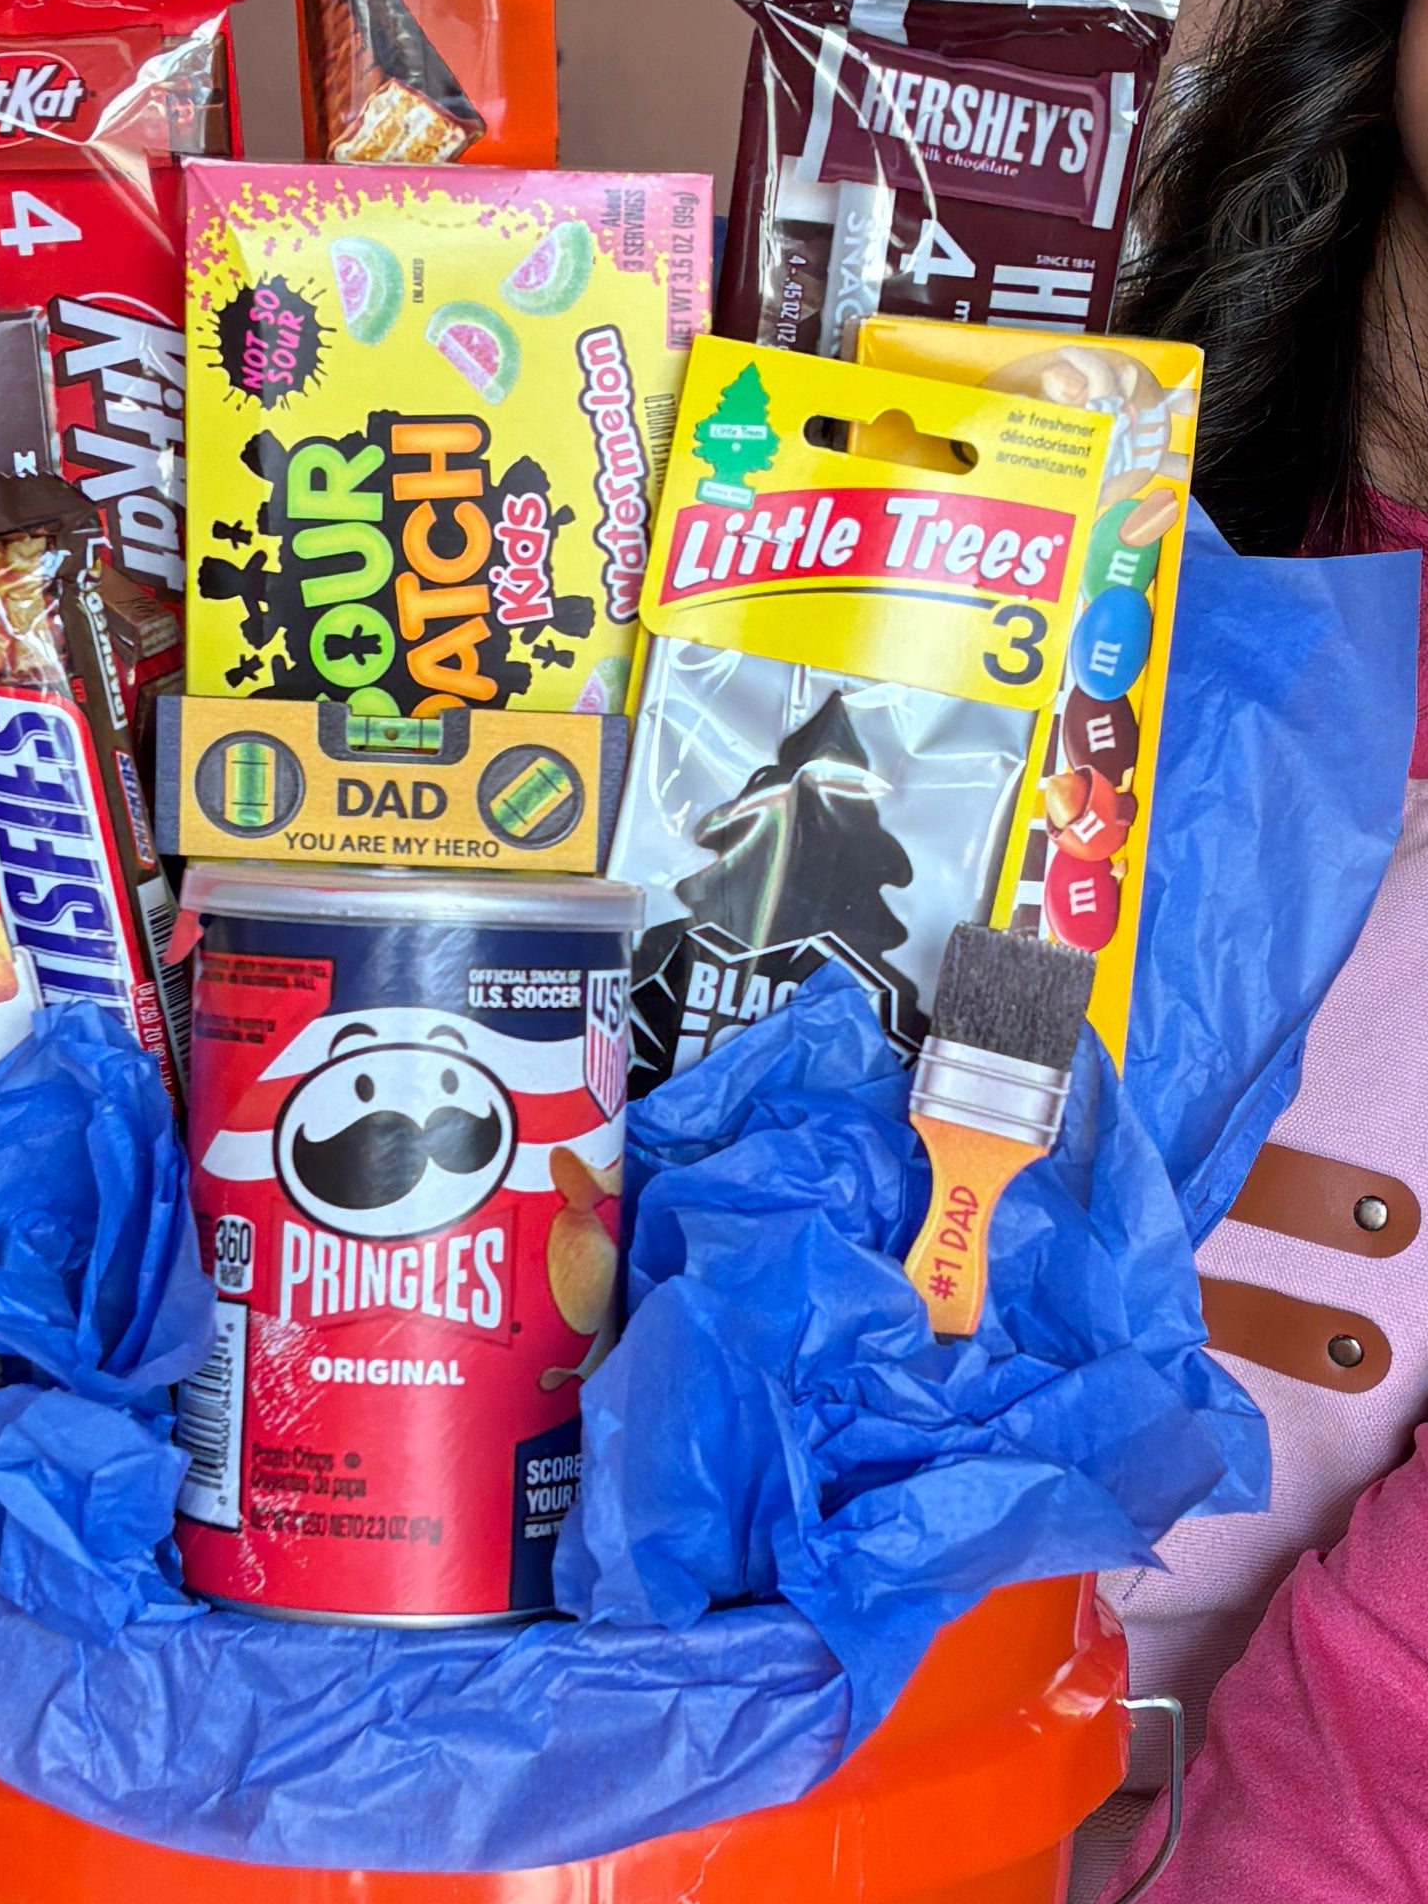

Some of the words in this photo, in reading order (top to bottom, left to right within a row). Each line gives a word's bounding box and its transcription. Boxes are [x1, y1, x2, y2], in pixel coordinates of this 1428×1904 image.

[858, 64, 1094, 174] HERSHEY'S
[945, 154, 1020, 178] chocolate
[0, 190, 83, 257] 4
[600, 188, 622, 228] About
[622, 189, 646, 257] SERVINGS
[671, 191, 700, 230] (99g)
[899, 218, 976, 285] 4
[671, 286, 694, 314] WT
[831, 211, 872, 357] SNAC
[249, 288, 281, 328] SO
[267, 309, 306, 386] SOUR
[671, 317, 693, 348] NET
[241, 329, 270, 391] NOT
[1000, 429, 1092, 458] désodorisant
[1006, 409, 1025, 424] air
[1026, 413, 1097, 439] freshener
[995, 450, 1088, 479] aromatizante
[492, 492, 554, 626] Kids
[671, 496, 860, 591] Little
[883, 496, 1054, 591] Trees
[390, 422, 499, 718] ATCH
[981, 606, 1049, 686] 3
[336, 777, 448, 821] DAD
[284, 831, 341, 853] YOU
[343, 834, 387, 855] ARE
[392, 837, 431, 856] MY
[434, 838, 501, 859] HERO
[468, 986, 509, 1009] U.S.
[511, 986, 582, 1009] SOCCER
[938, 1184, 980, 1252] DAD
[215, 1219, 252, 1266] 360
[279, 1219, 506, 1330] PRINGLES
[928, 1257, 963, 1300] #1
[310, 1356, 466, 1386] ORIGINAL
